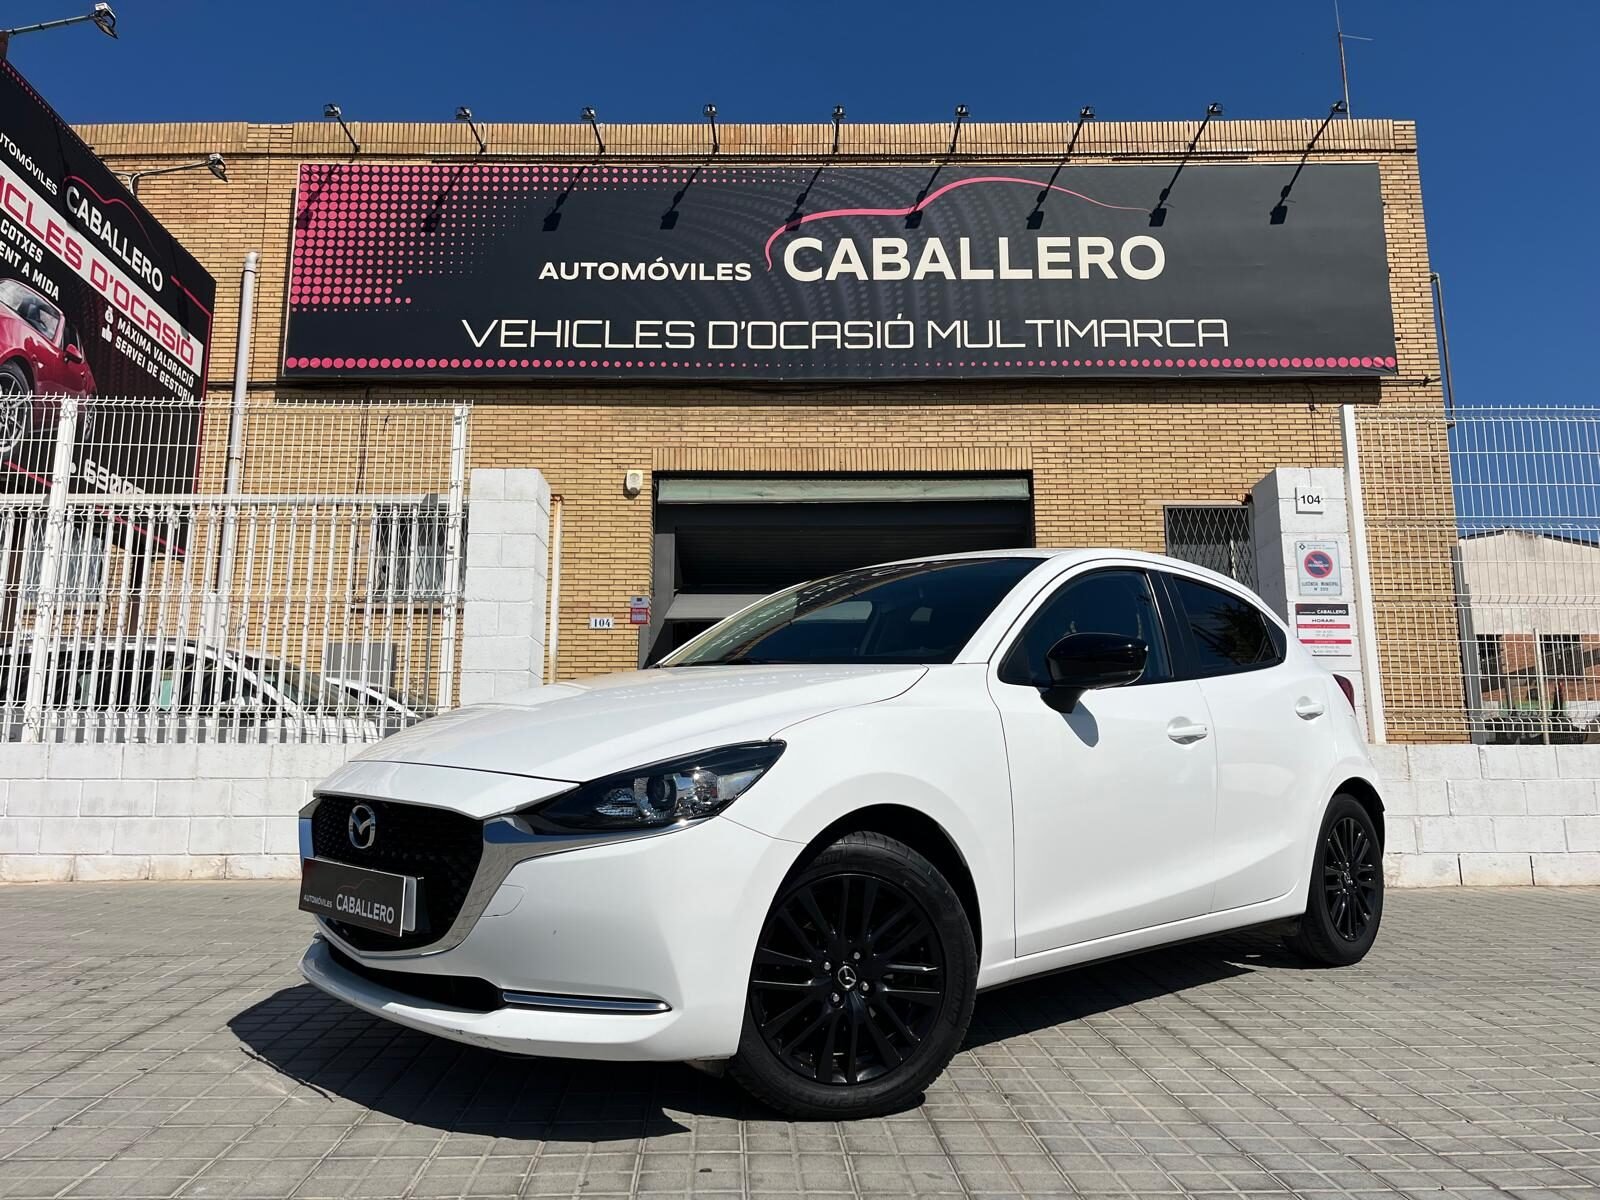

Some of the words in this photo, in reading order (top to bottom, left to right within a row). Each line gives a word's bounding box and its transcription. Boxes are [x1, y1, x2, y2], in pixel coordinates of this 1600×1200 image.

[1, 218, 43, 263] COTXES
[66, 185, 163, 292] CABALLERO
[538, 256, 751, 282] AUTOMÓVILES
[783, 235, 1165, 282] CABALLERO
[21, 261, 30, 278] A
[32, 268, 59, 301] MIDA
[90, 258, 194, 366] D'OCASIÓ
[461, 319, 695, 349] VEHICLES
[708, 312, 914, 349] D'OCASIÓ
[928, 319, 1229, 349] MULTIMARCA
[115, 336, 146, 368] SERVEI
[146, 361, 159, 378] DE
[159, 370, 195, 405] GESTORIA
[117, 317, 151, 354] MÀXIMA
[153, 346, 194, 388] VALORACIÓ
[1300, 494, 1321, 505] 104
[594, 618, 610, 628] 104
[303, 893, 333, 908] AUTOMÓVILES
[336, 893, 395, 924] CABALLERO
